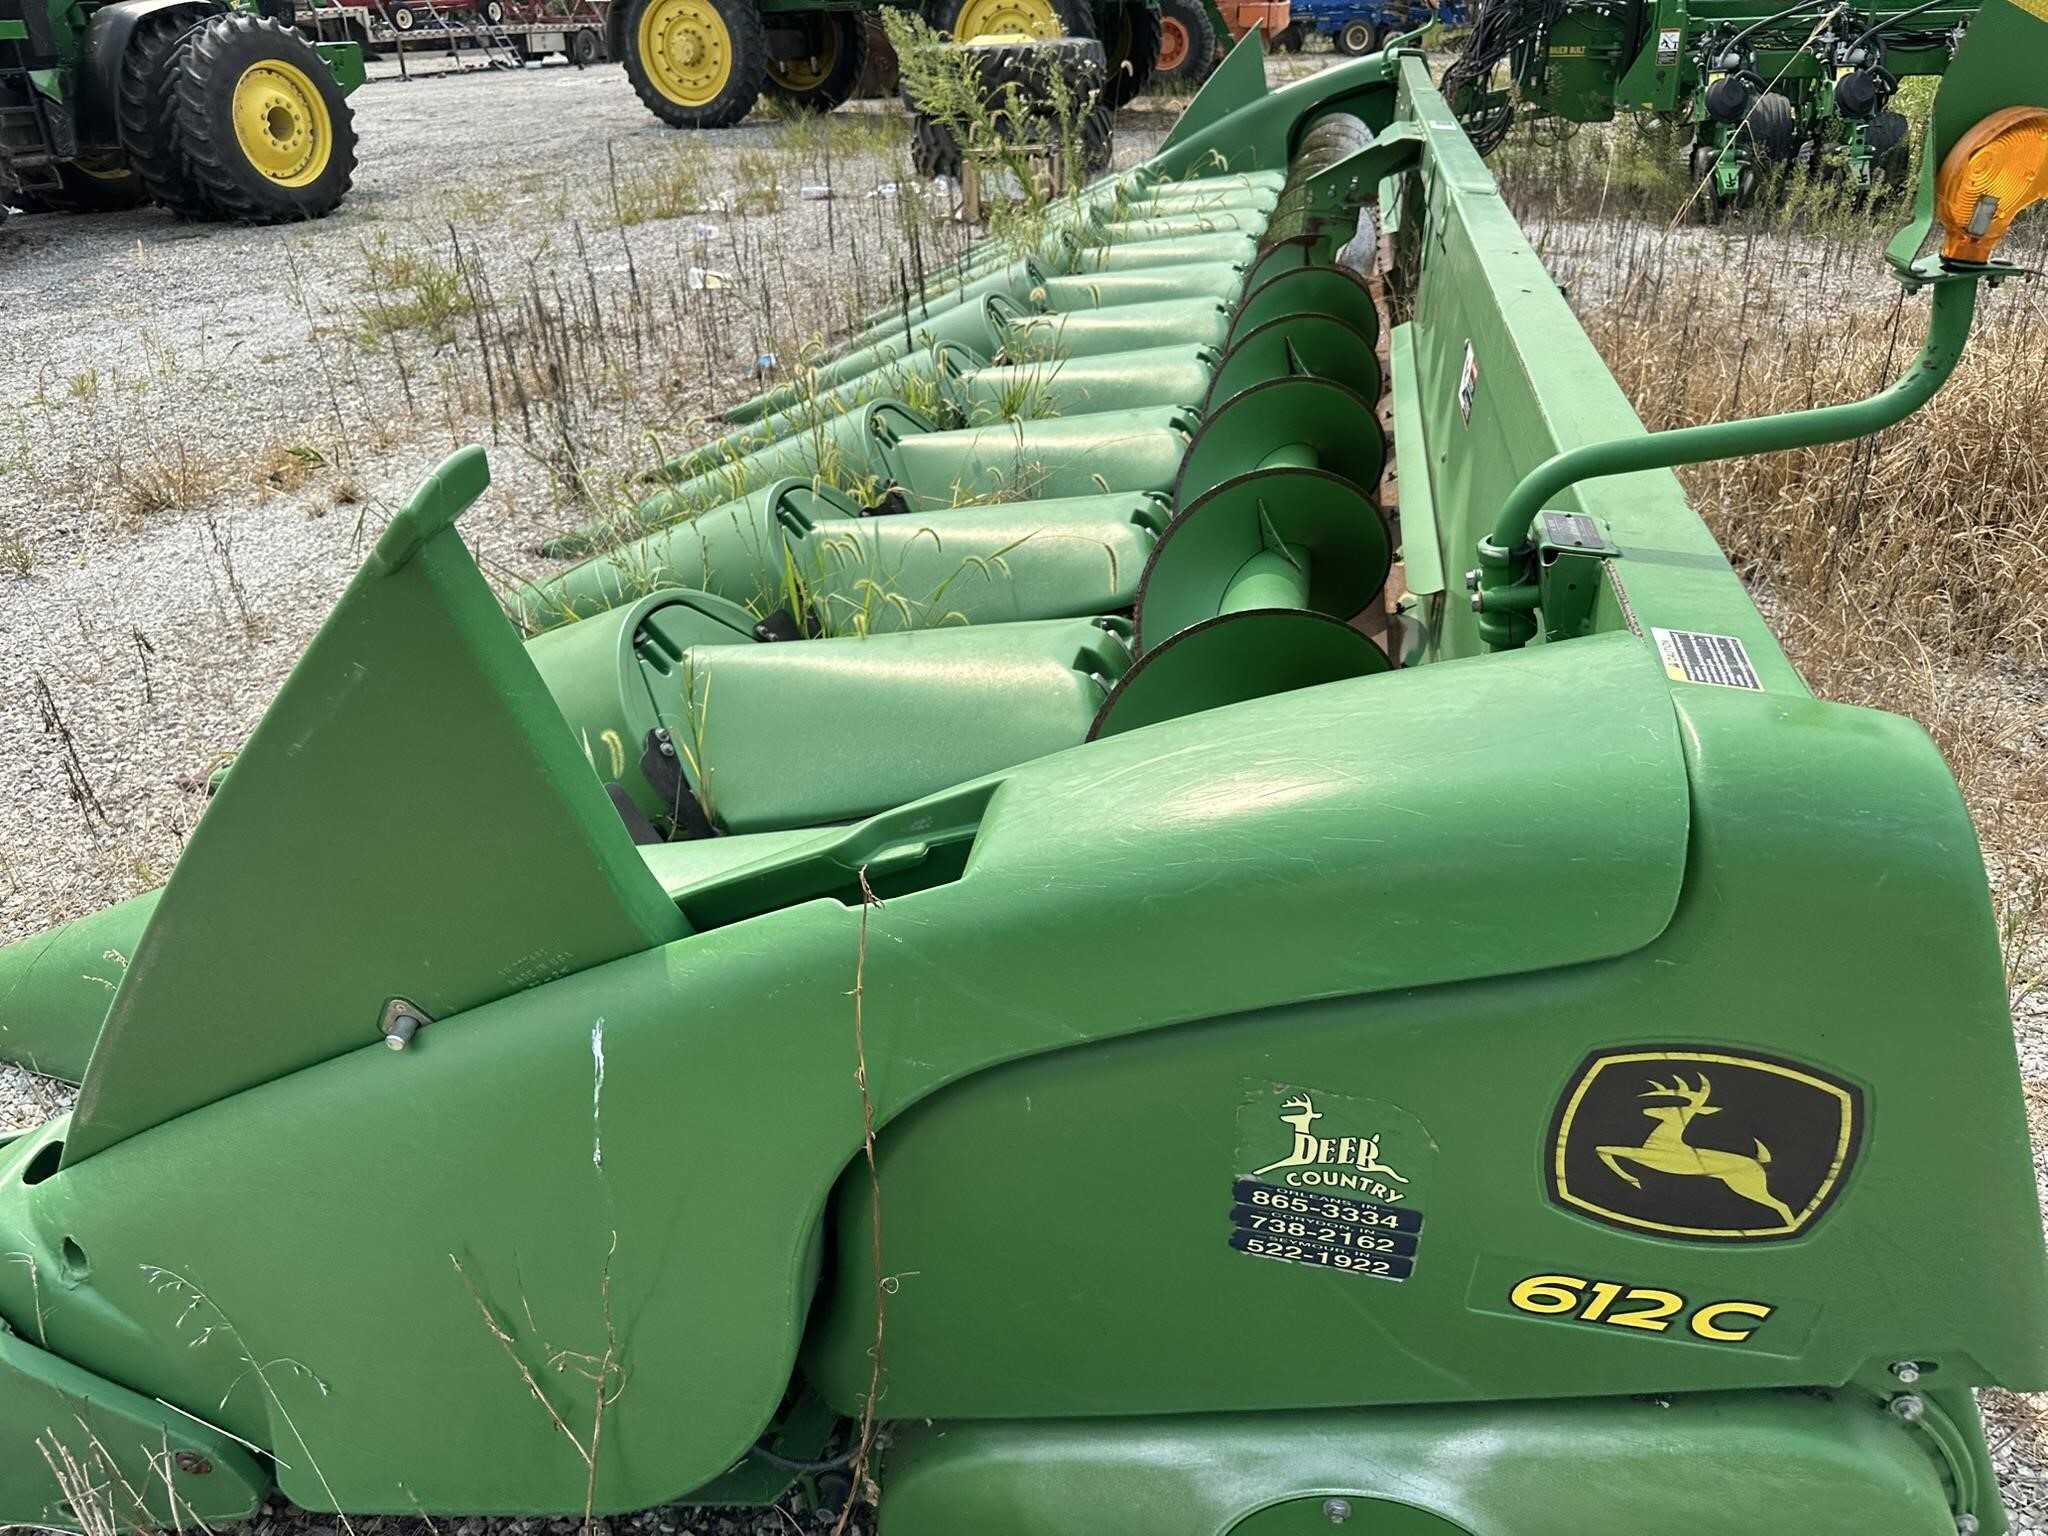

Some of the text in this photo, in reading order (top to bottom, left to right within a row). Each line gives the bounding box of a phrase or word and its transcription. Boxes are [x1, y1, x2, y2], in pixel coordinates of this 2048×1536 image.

[1285, 1170, 1405, 1204] COUNTRY
[1251, 1190, 1399, 1229] 865-3334
[1361, 1203, 1377, 1211] IN
[1250, 1214, 1395, 1253] 738-2162
[1246, 1239, 1391, 1275] 522-1922
